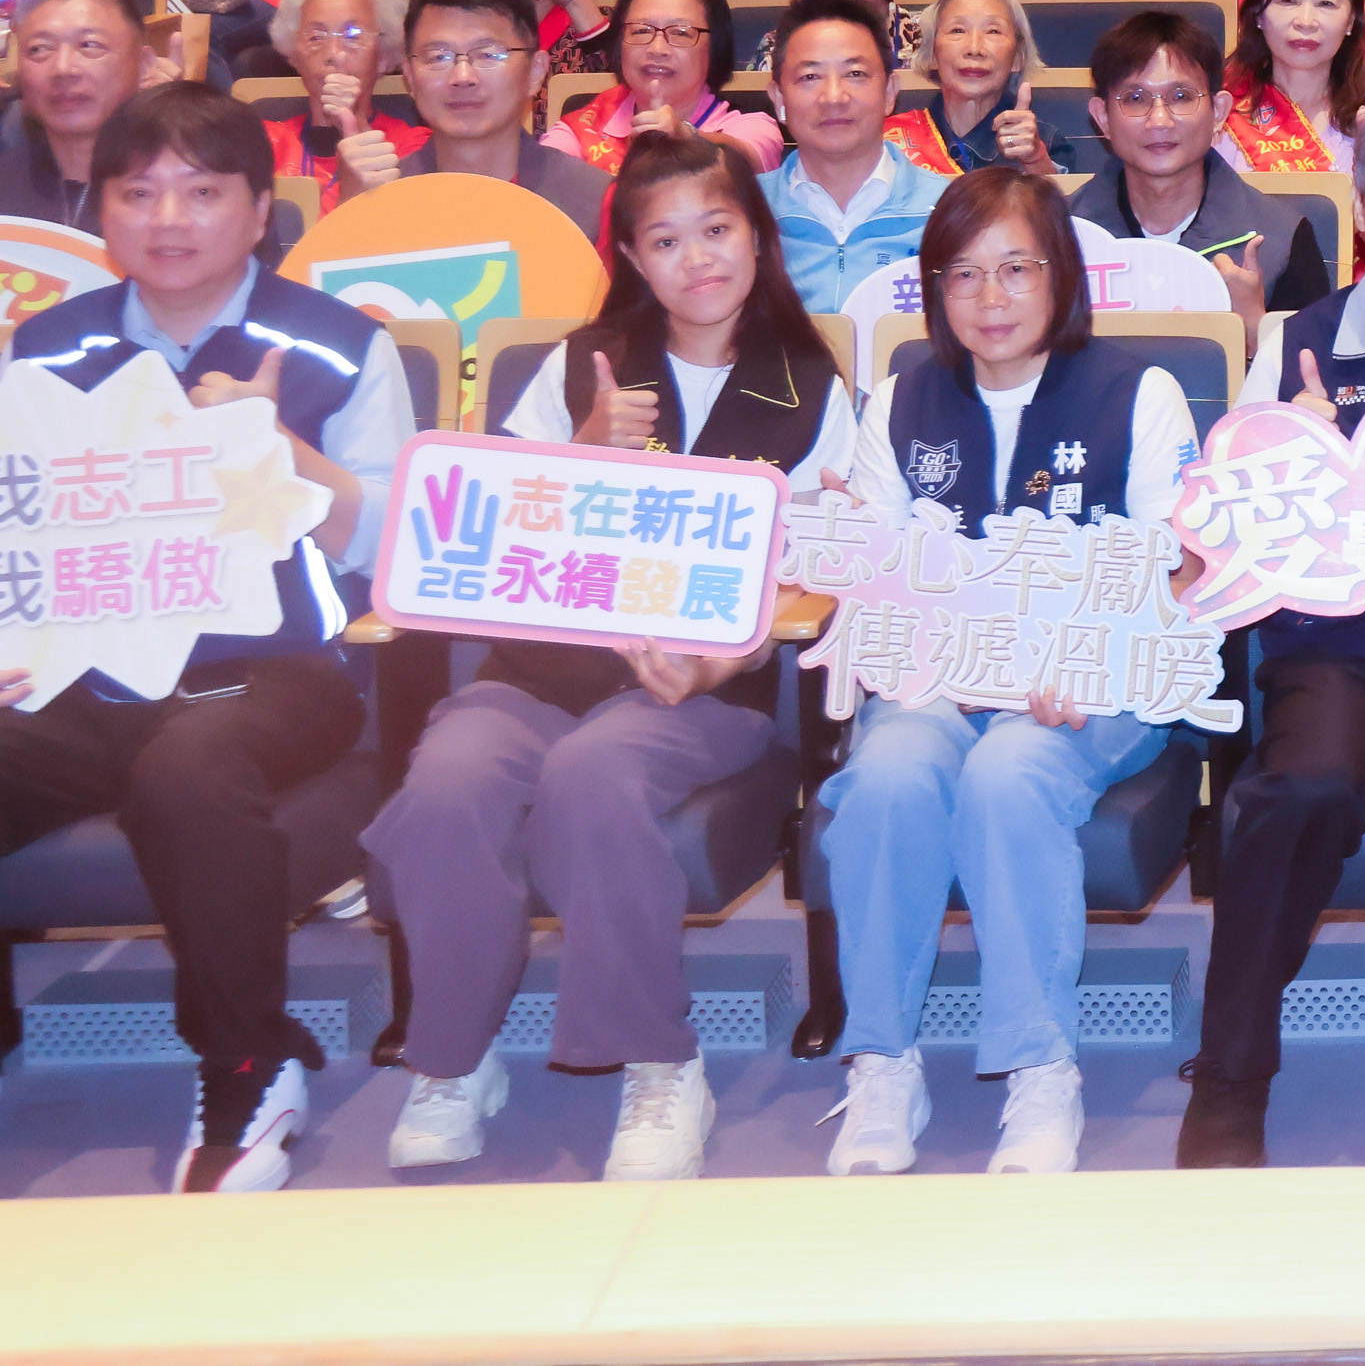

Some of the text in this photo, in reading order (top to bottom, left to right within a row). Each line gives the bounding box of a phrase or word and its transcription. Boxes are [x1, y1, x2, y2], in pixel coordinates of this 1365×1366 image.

[1256, 135, 1302, 154] 2026
[923, 452, 947, 465] GO
[504, 475, 752, 551] 志在新北
[417, 565, 484, 602] 26
[493, 545, 744, 623] 永續發展
[782, 502, 1181, 626] 志心奉獻
[821, 598, 1237, 726] 傳遞溫暖
